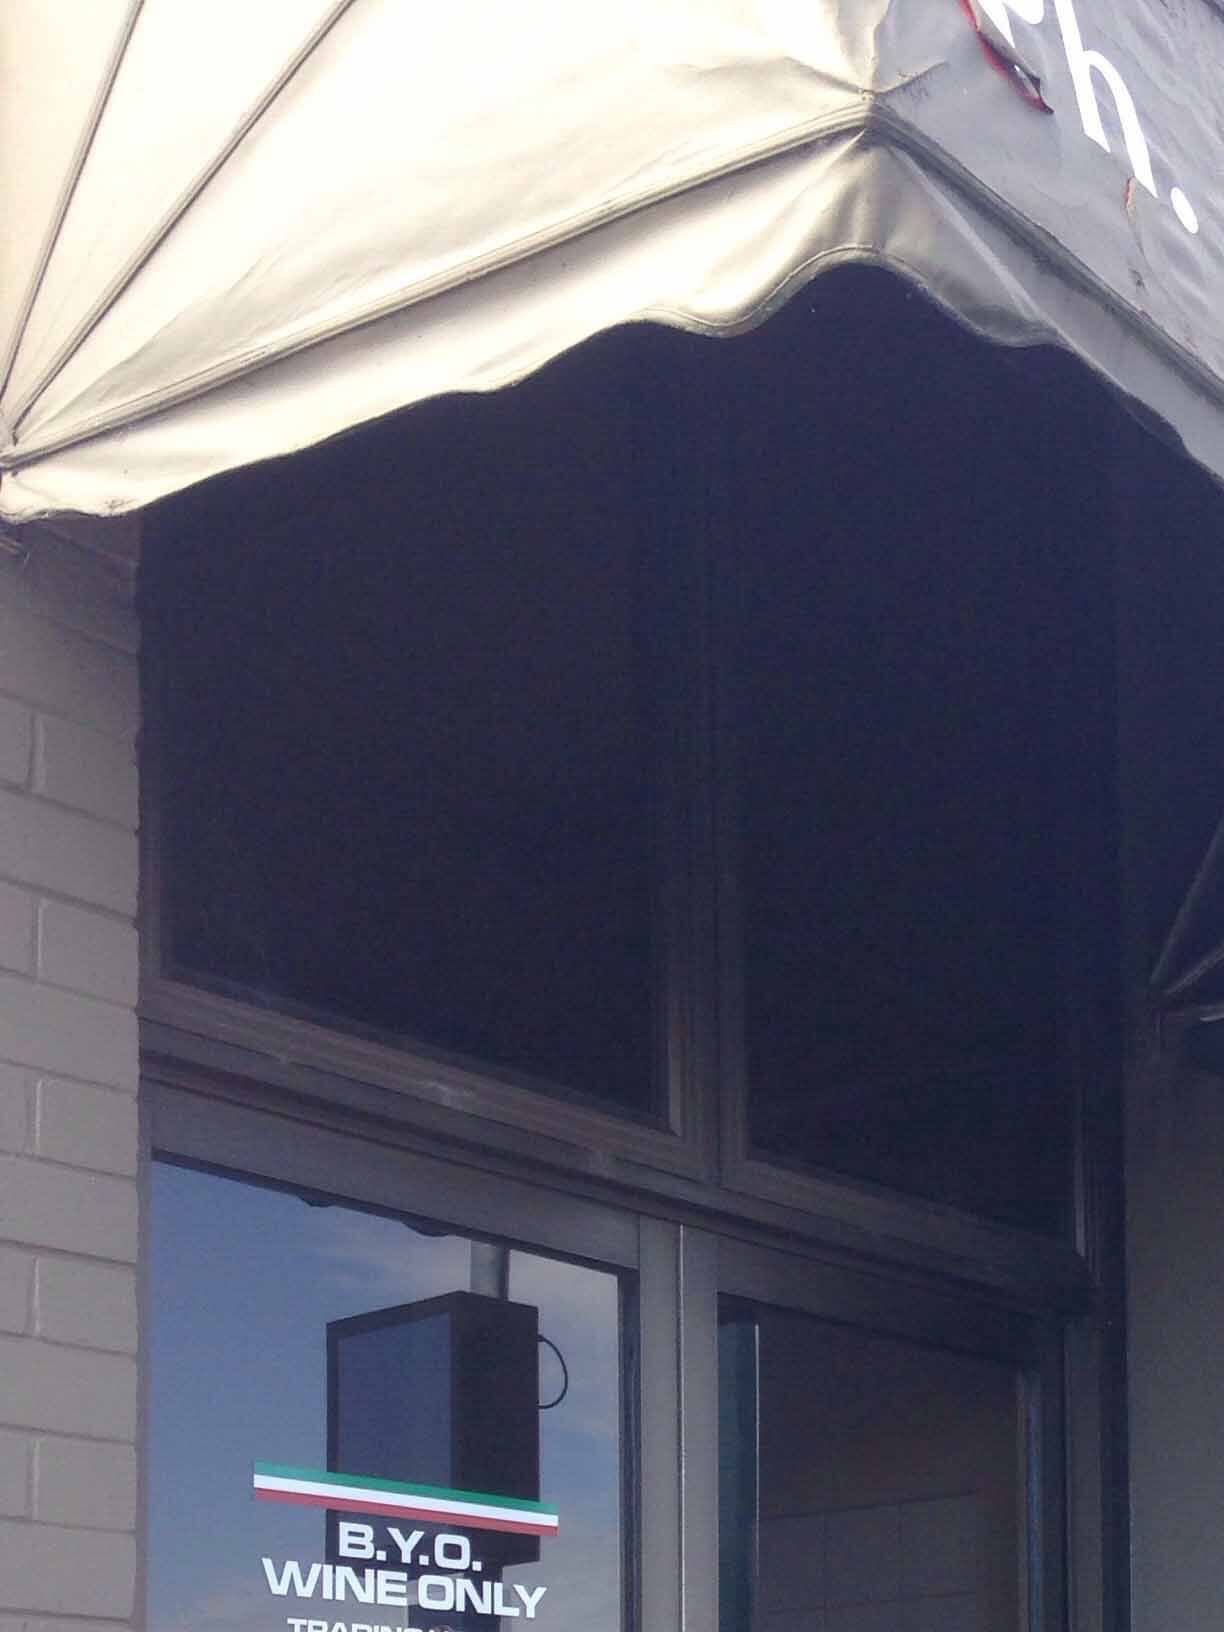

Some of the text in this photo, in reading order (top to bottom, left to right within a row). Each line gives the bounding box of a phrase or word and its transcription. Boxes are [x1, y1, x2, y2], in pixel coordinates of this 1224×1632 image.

[978, 0, 1198, 234] h.
[338, 1521, 482, 1571] B.Y.O.
[262, 1558, 547, 1618] WINE ONLY
